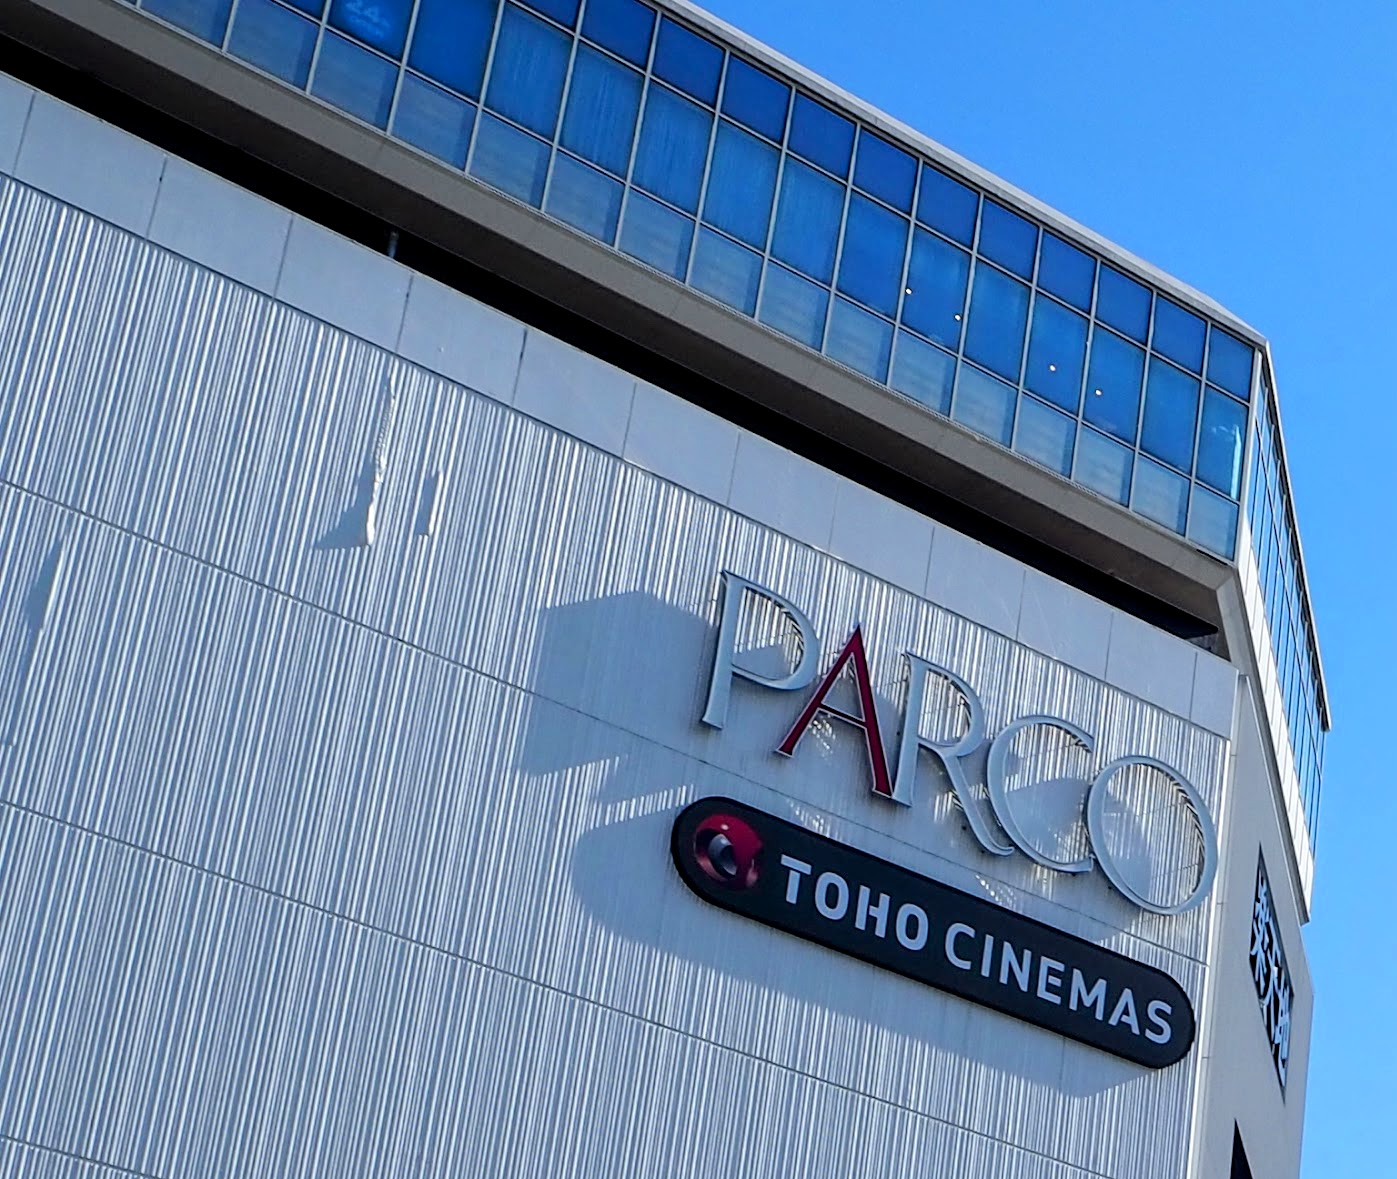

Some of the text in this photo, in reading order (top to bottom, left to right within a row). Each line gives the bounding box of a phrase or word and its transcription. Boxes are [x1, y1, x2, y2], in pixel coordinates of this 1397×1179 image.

[701, 570, 1219, 915] PARCO
[780, 853, 1172, 1045] TOHO CINEMAS
